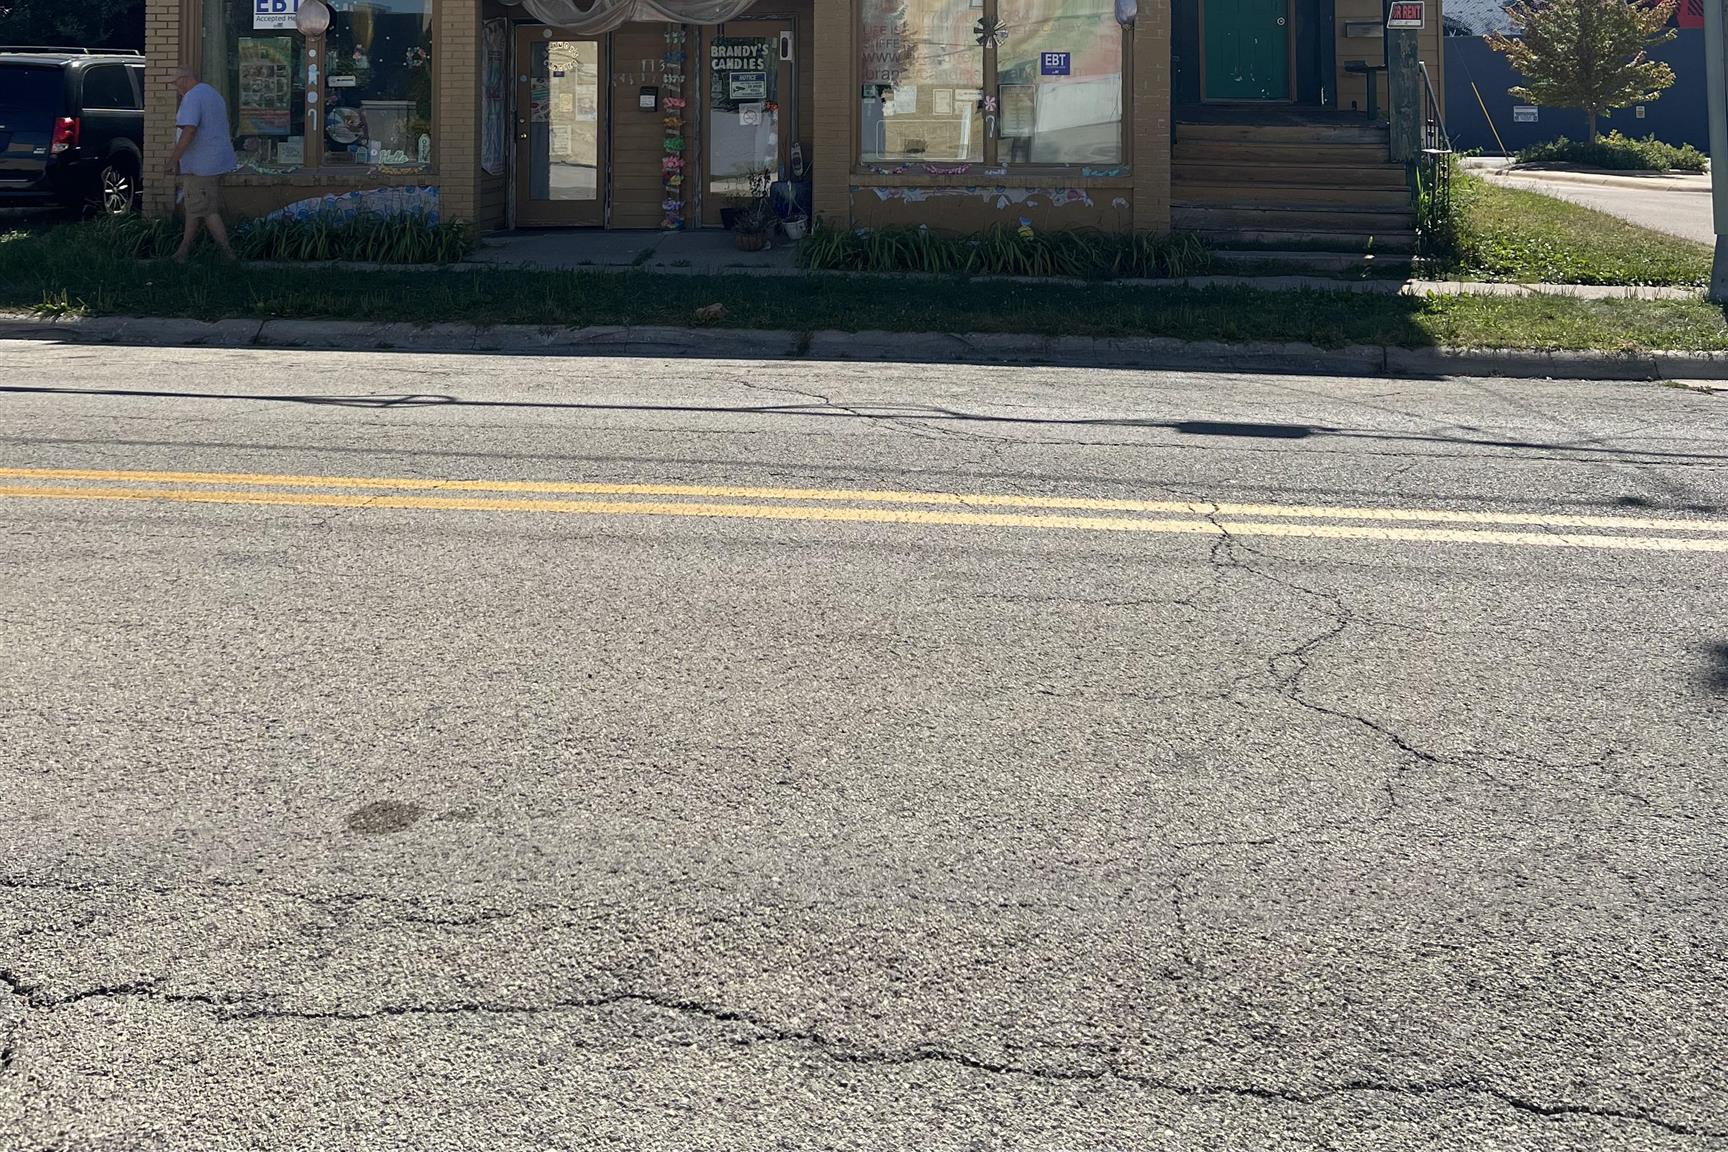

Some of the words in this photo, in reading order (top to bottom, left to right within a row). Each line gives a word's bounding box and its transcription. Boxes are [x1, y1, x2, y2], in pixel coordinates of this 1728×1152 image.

[1402, 4, 1420, 18] RENT
[711, 44, 769, 57] BRANDY'S
[711, 58, 764, 70] CANDIES
[1045, 53, 1066, 66] EBT
